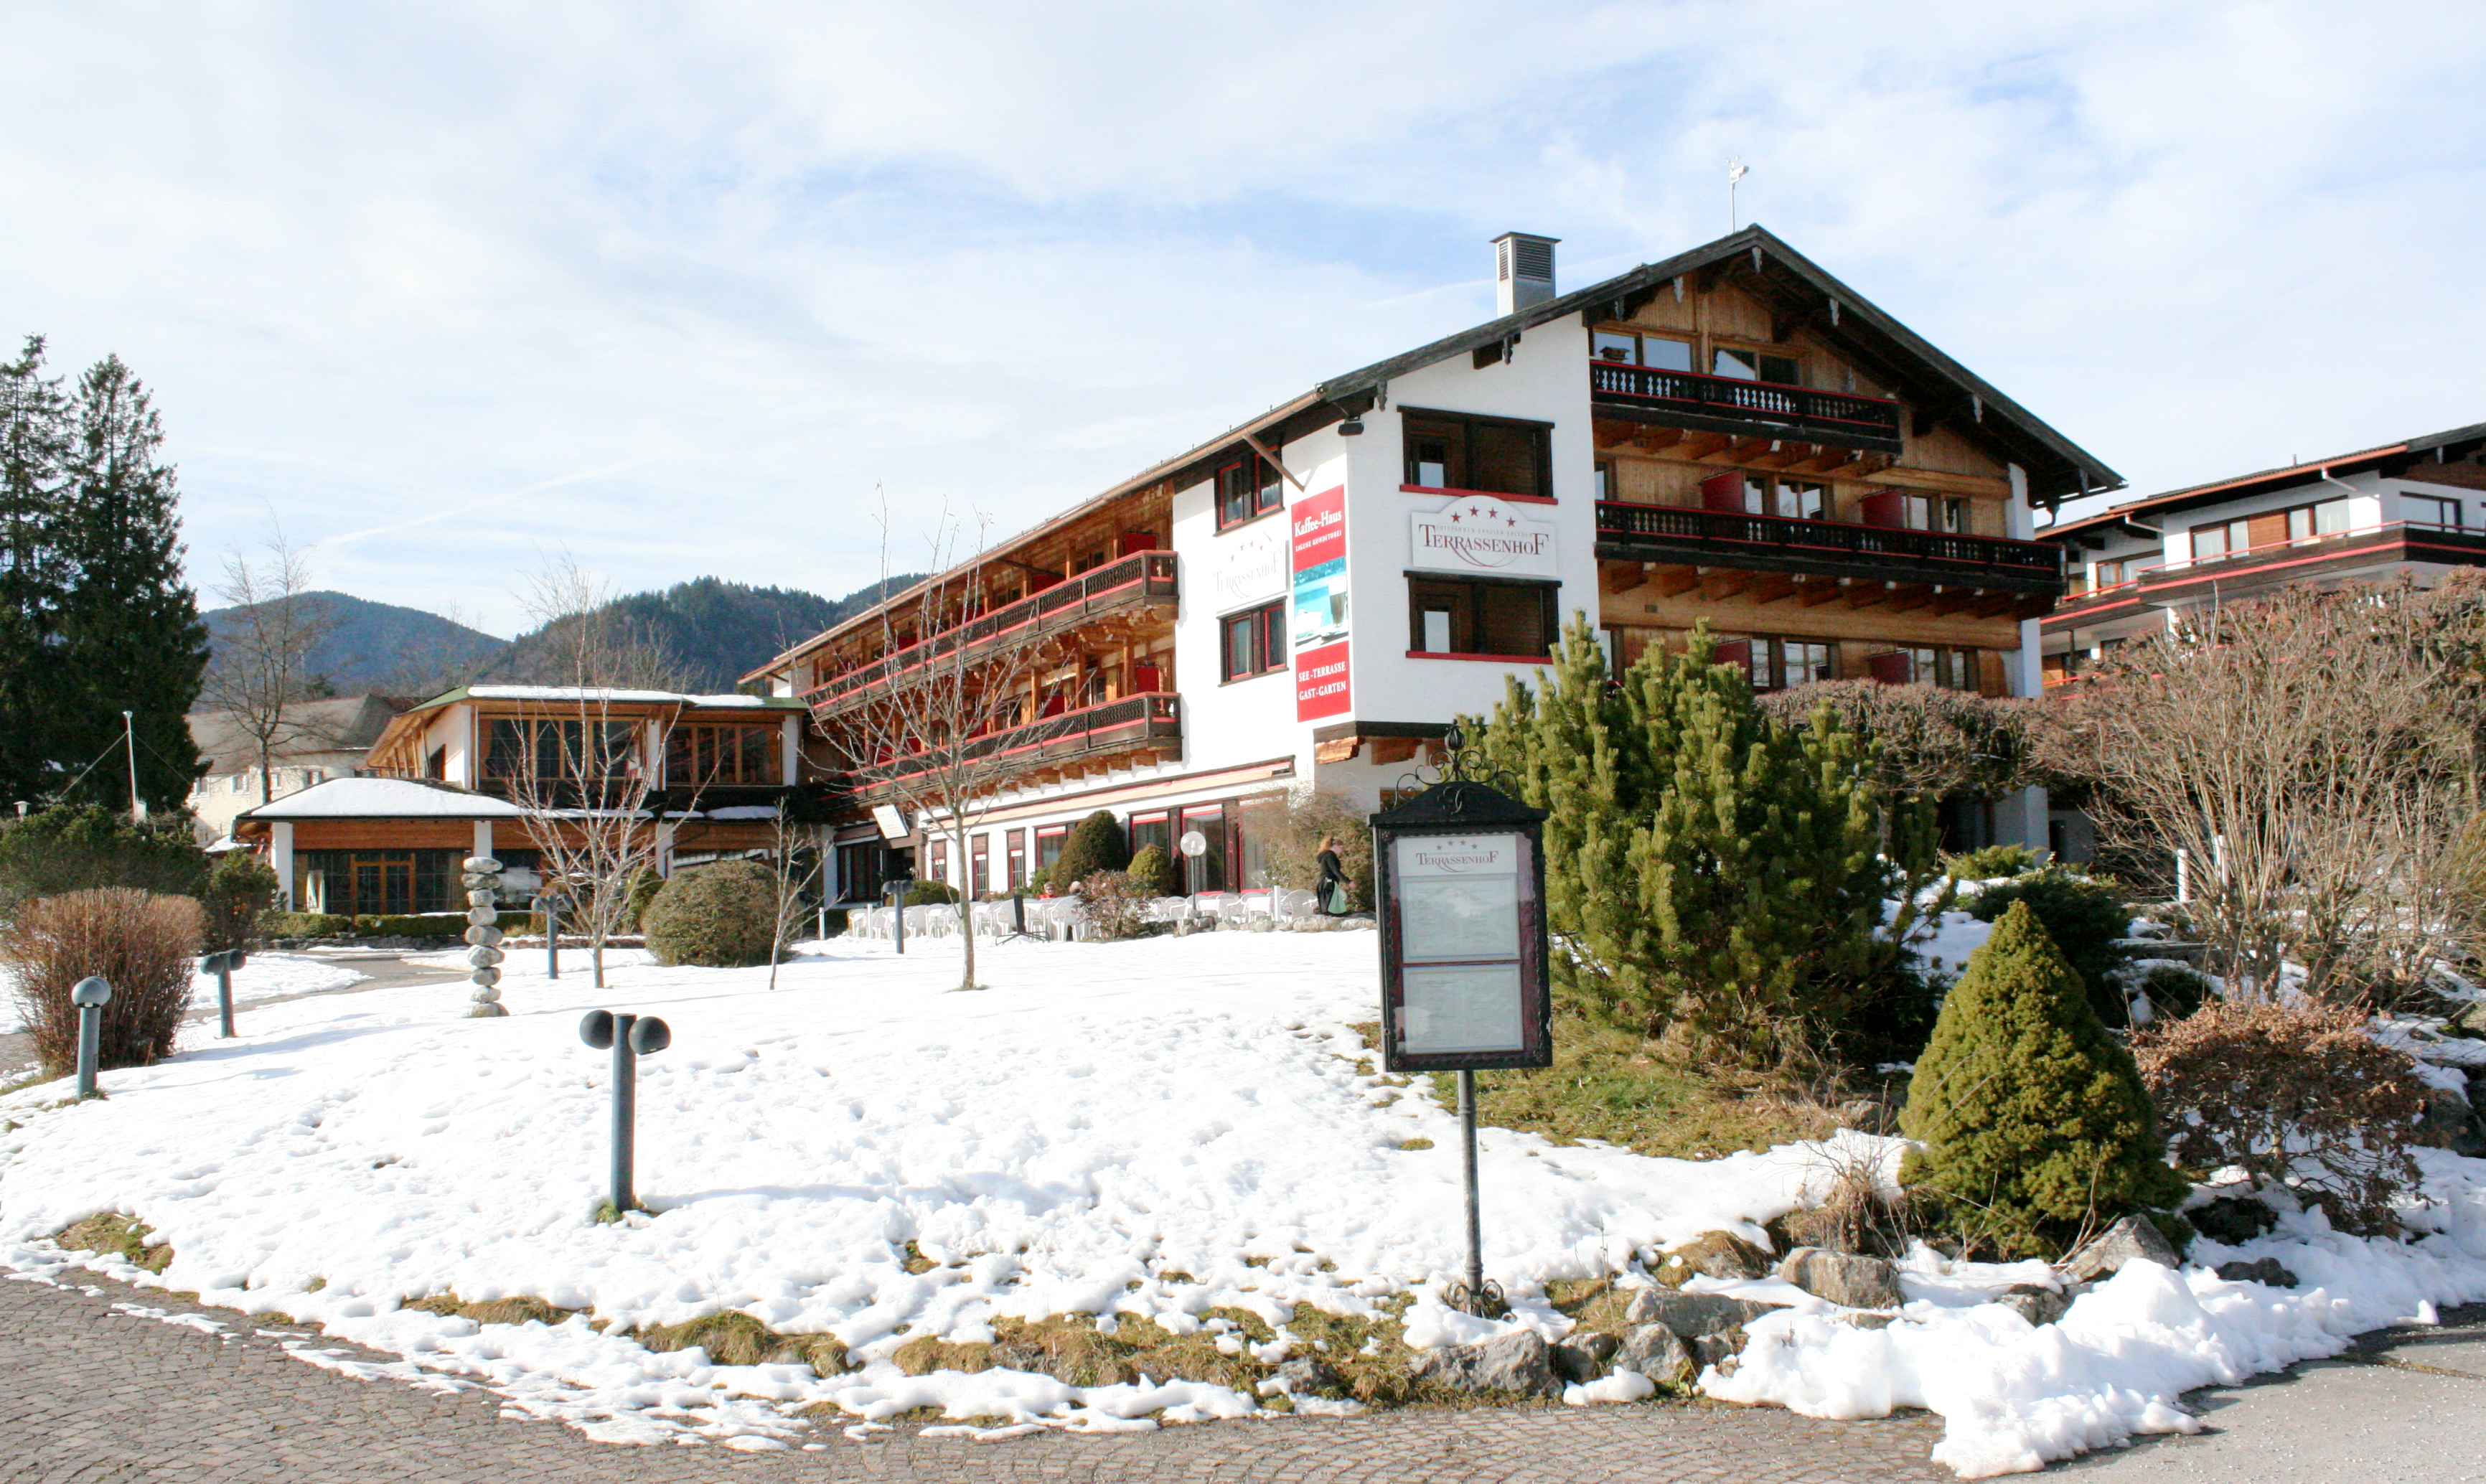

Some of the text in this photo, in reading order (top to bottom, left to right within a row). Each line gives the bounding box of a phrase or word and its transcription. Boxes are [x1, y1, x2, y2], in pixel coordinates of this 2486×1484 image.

[1294, 509, 1342, 537] Kaffee-Haus
[1418, 524, 1549, 555] TERRASSENHOF
[1298, 661, 1346, 682] SEE-TERRASSE
[1299, 680, 1346, 700] GAST-GARTEN
[1416, 850, 1499, 865] TERRASSENHOF
